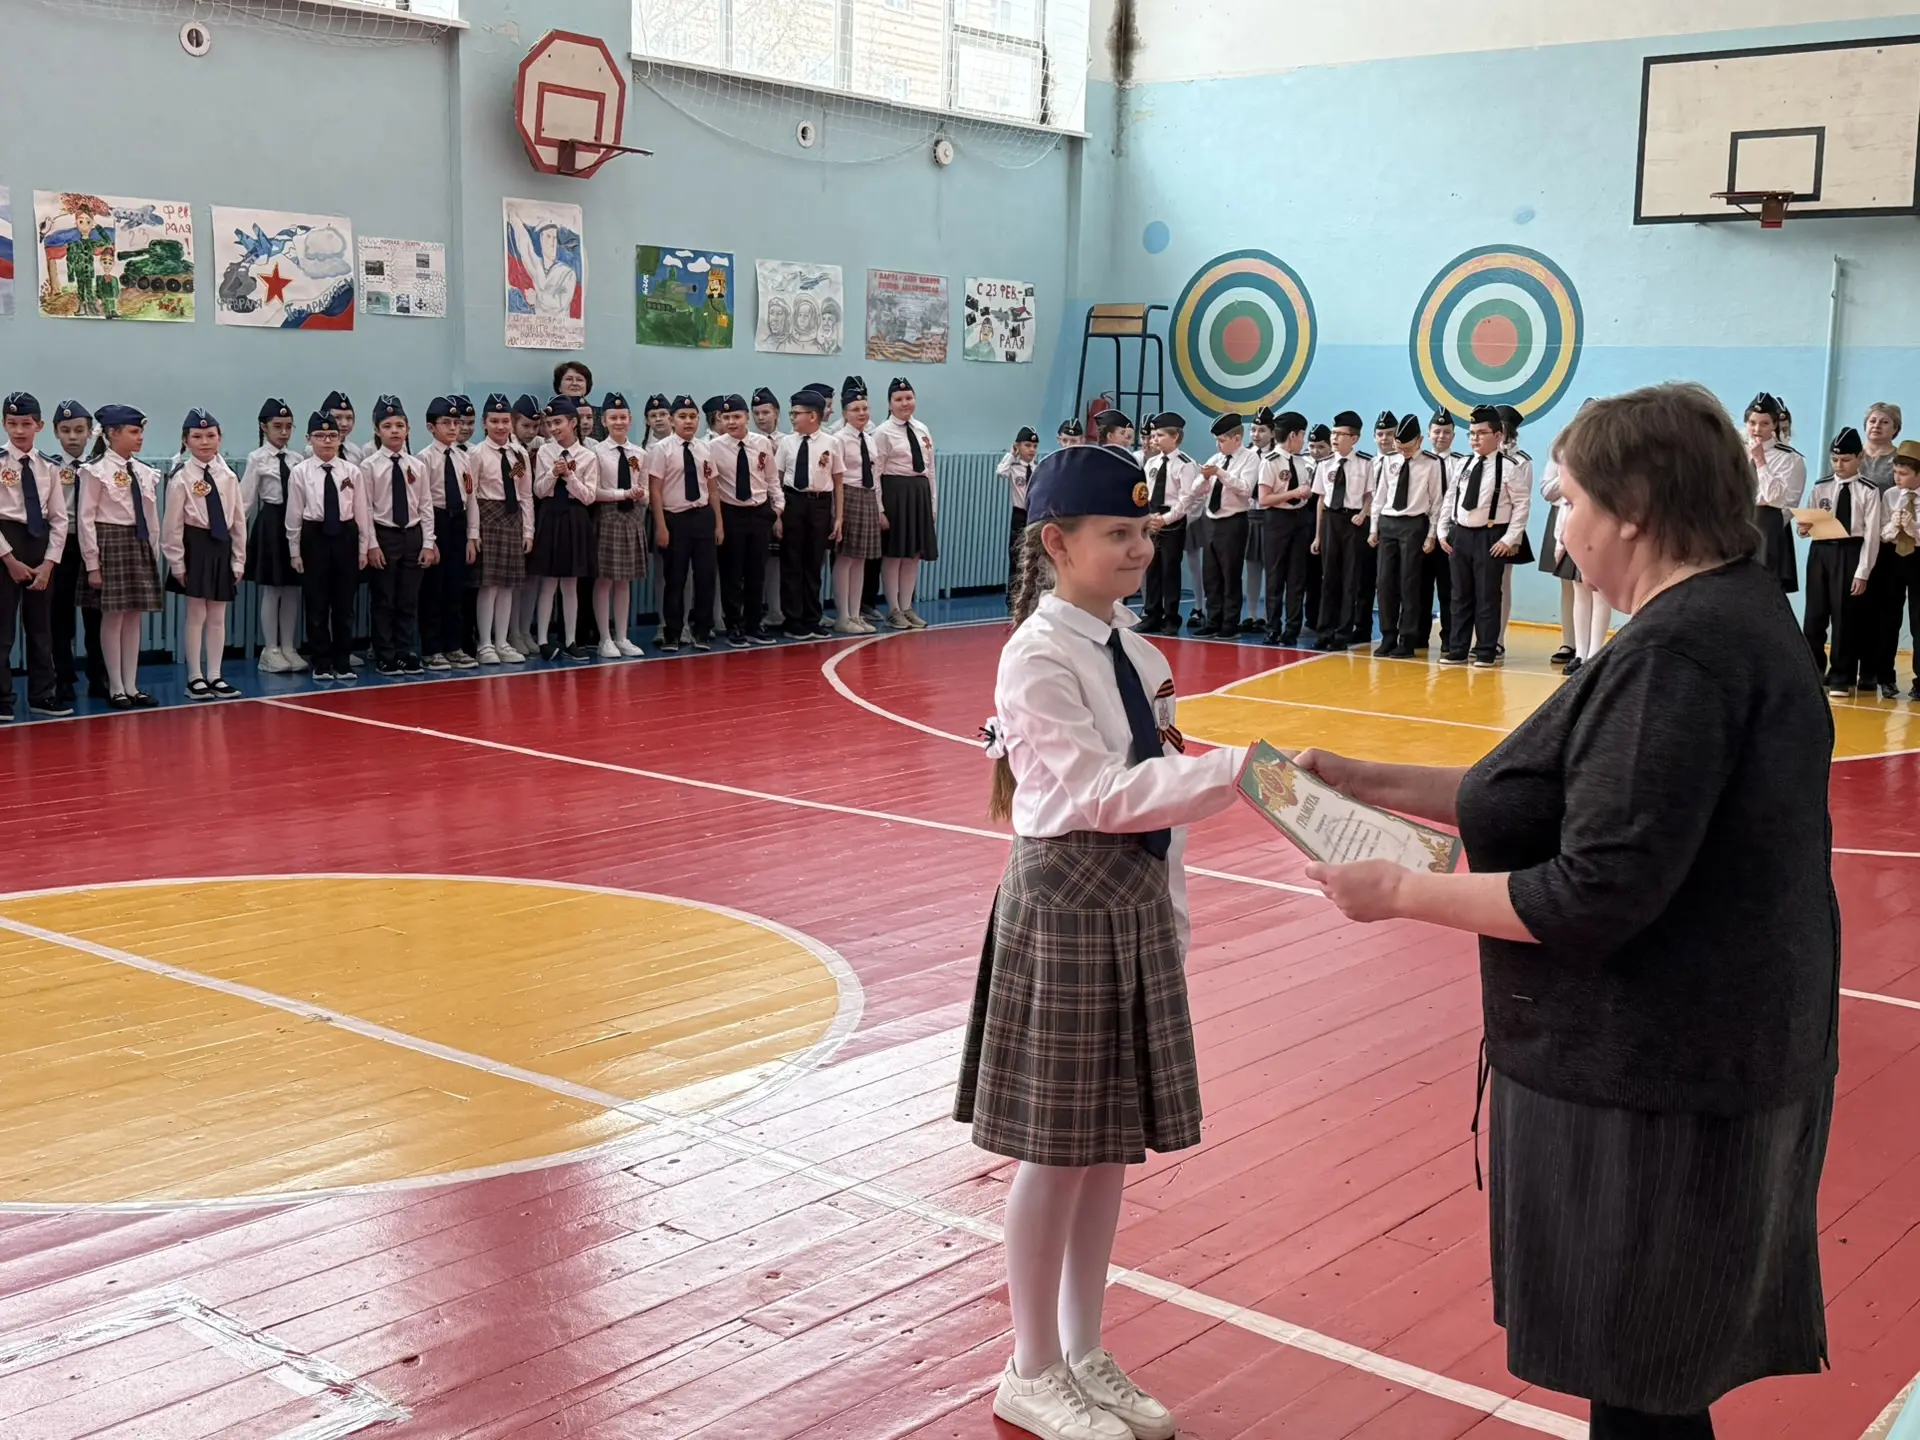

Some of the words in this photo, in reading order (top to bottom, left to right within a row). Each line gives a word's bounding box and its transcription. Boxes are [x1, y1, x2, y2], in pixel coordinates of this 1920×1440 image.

[977, 283, 984, 295] С
[986, 283, 997, 297] 23
[216, 297, 263, 311] ФЕВРАЛЯ
[1000, 333, 1025, 349] РАЛЯ
[1296, 793, 1320, 829] ГРАМОТА
